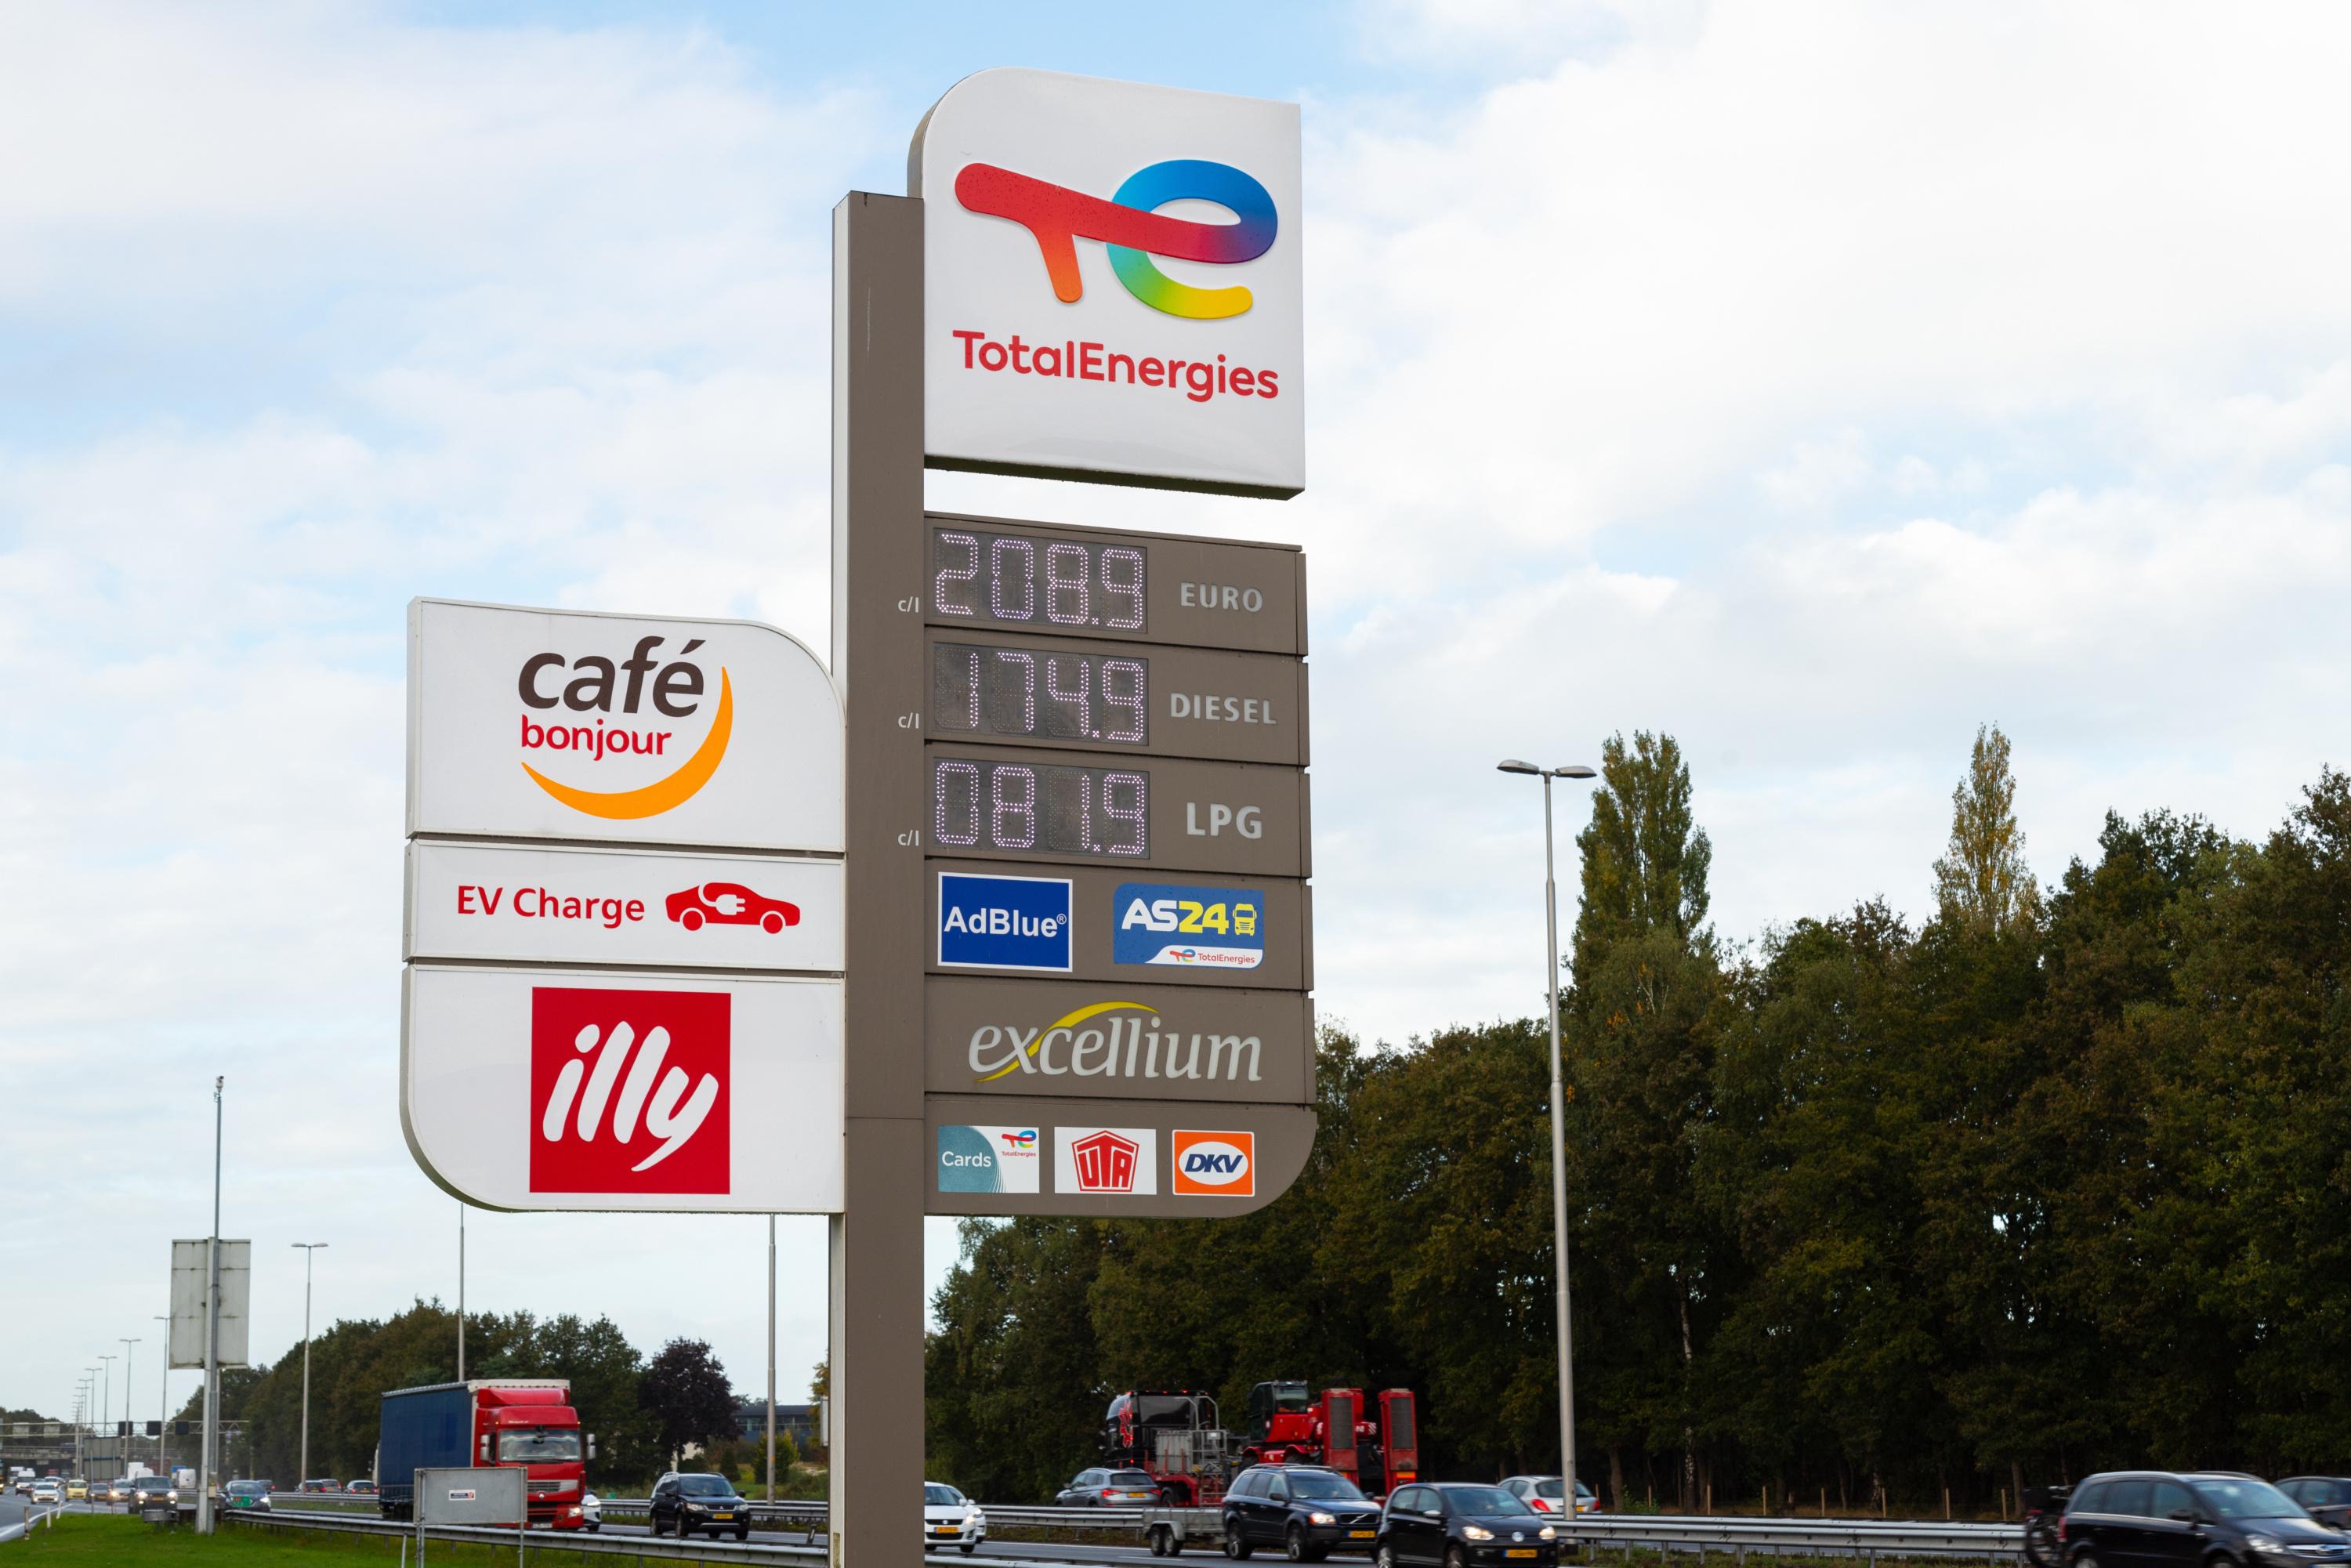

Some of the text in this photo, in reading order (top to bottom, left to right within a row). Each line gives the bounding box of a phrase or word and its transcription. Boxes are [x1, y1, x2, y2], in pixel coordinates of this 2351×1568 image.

[952, 330, 1278, 402] TotalEnergies
[936, 534, 1143, 628] 208.9
[1180, 581, 1263, 612] EURO
[897, 596, 919, 614] c/l
[518, 636, 706, 718] café
[897, 712, 919, 730] c/l
[1170, 693, 1277, 725] DIESEL
[521, 714, 672, 761] bonjour
[897, 829, 919, 846] c/l
[1186, 802, 1263, 838] LPG
[458, 885, 646, 929] EV Charge
[1121, 897, 1230, 935] AS24
[1197, 953, 1255, 965] TotalEnergies
[969, 1016, 1262, 1082] excellium
[543, 1020, 719, 1172] illy
[942, 1151, 991, 1167] Cards
[1077, 1134, 1135, 1188] UTA
[1185, 1153, 1243, 1173] DKV
